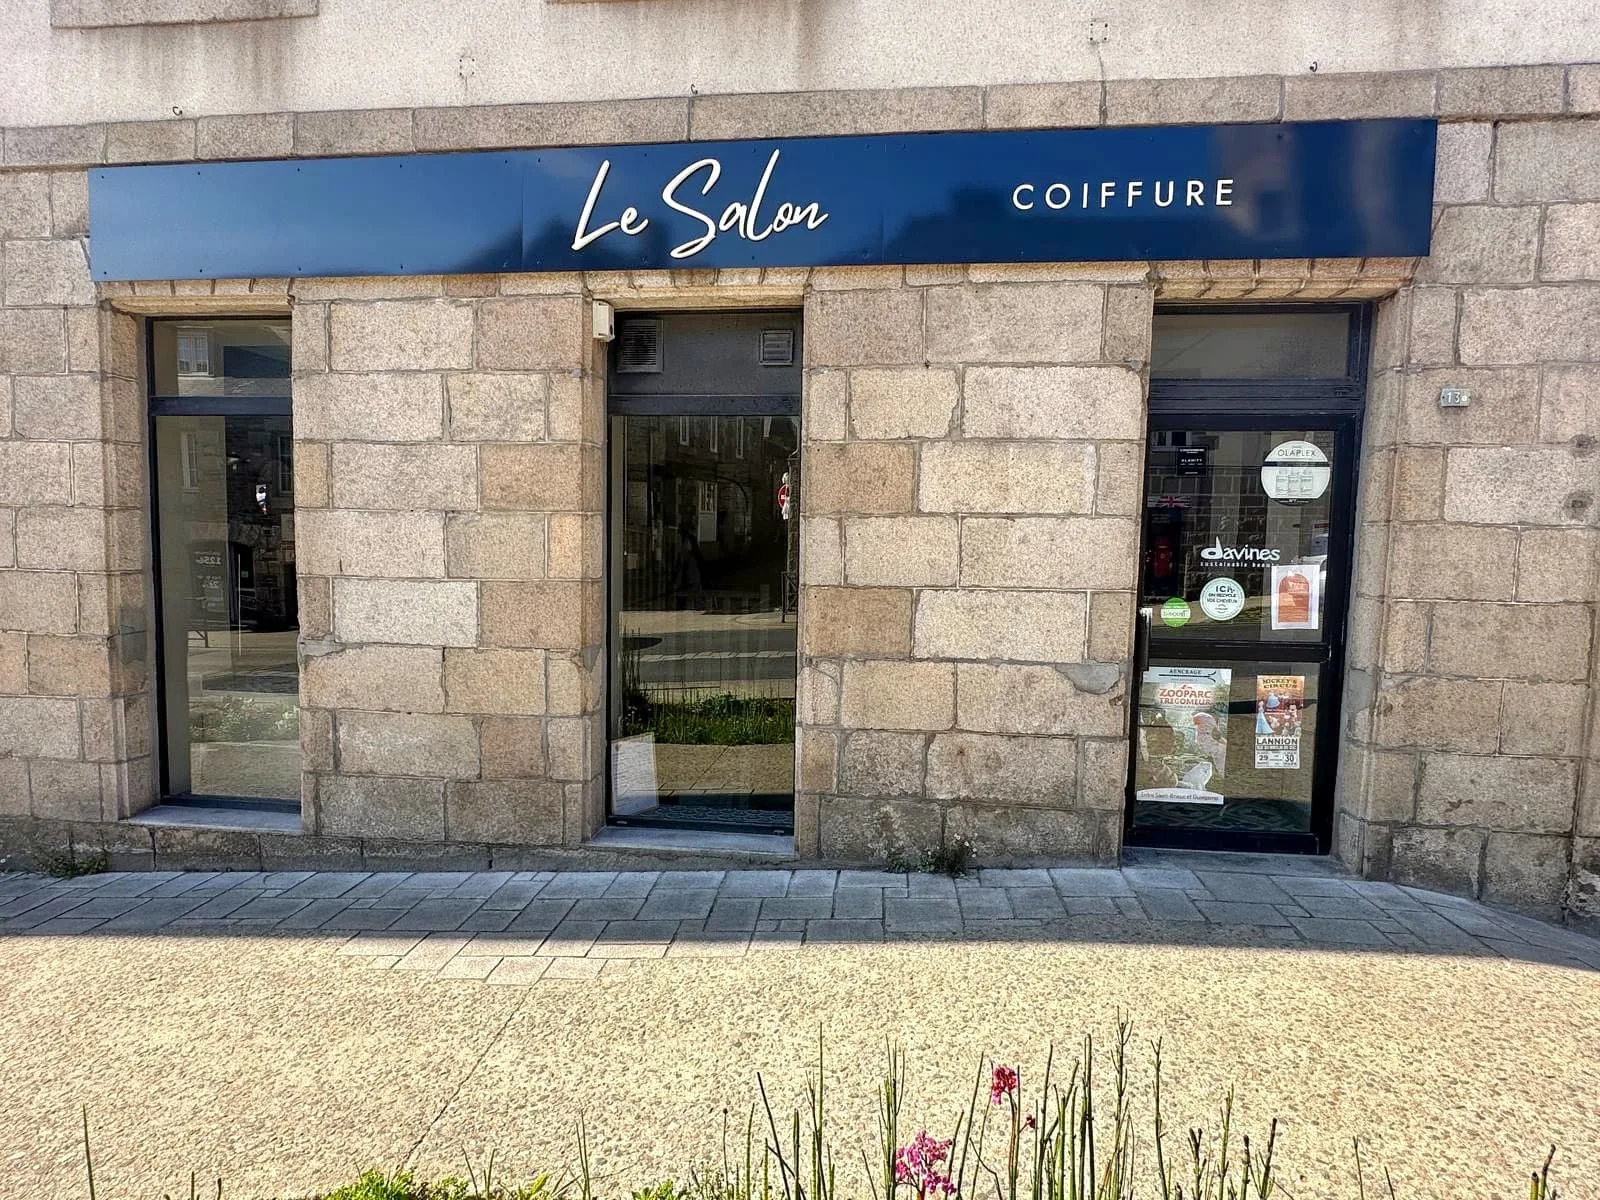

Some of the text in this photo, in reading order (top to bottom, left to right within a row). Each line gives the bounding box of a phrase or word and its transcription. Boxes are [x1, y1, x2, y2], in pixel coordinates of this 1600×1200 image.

[571, 149, 829, 258] Le Salon
[1012, 179, 1234, 210] COIFFURE
[1277, 449, 1317, 457] OLAPLEX
[1200, 535, 1281, 561] davines
[1159, 688, 1212, 698] ZOOPARC
